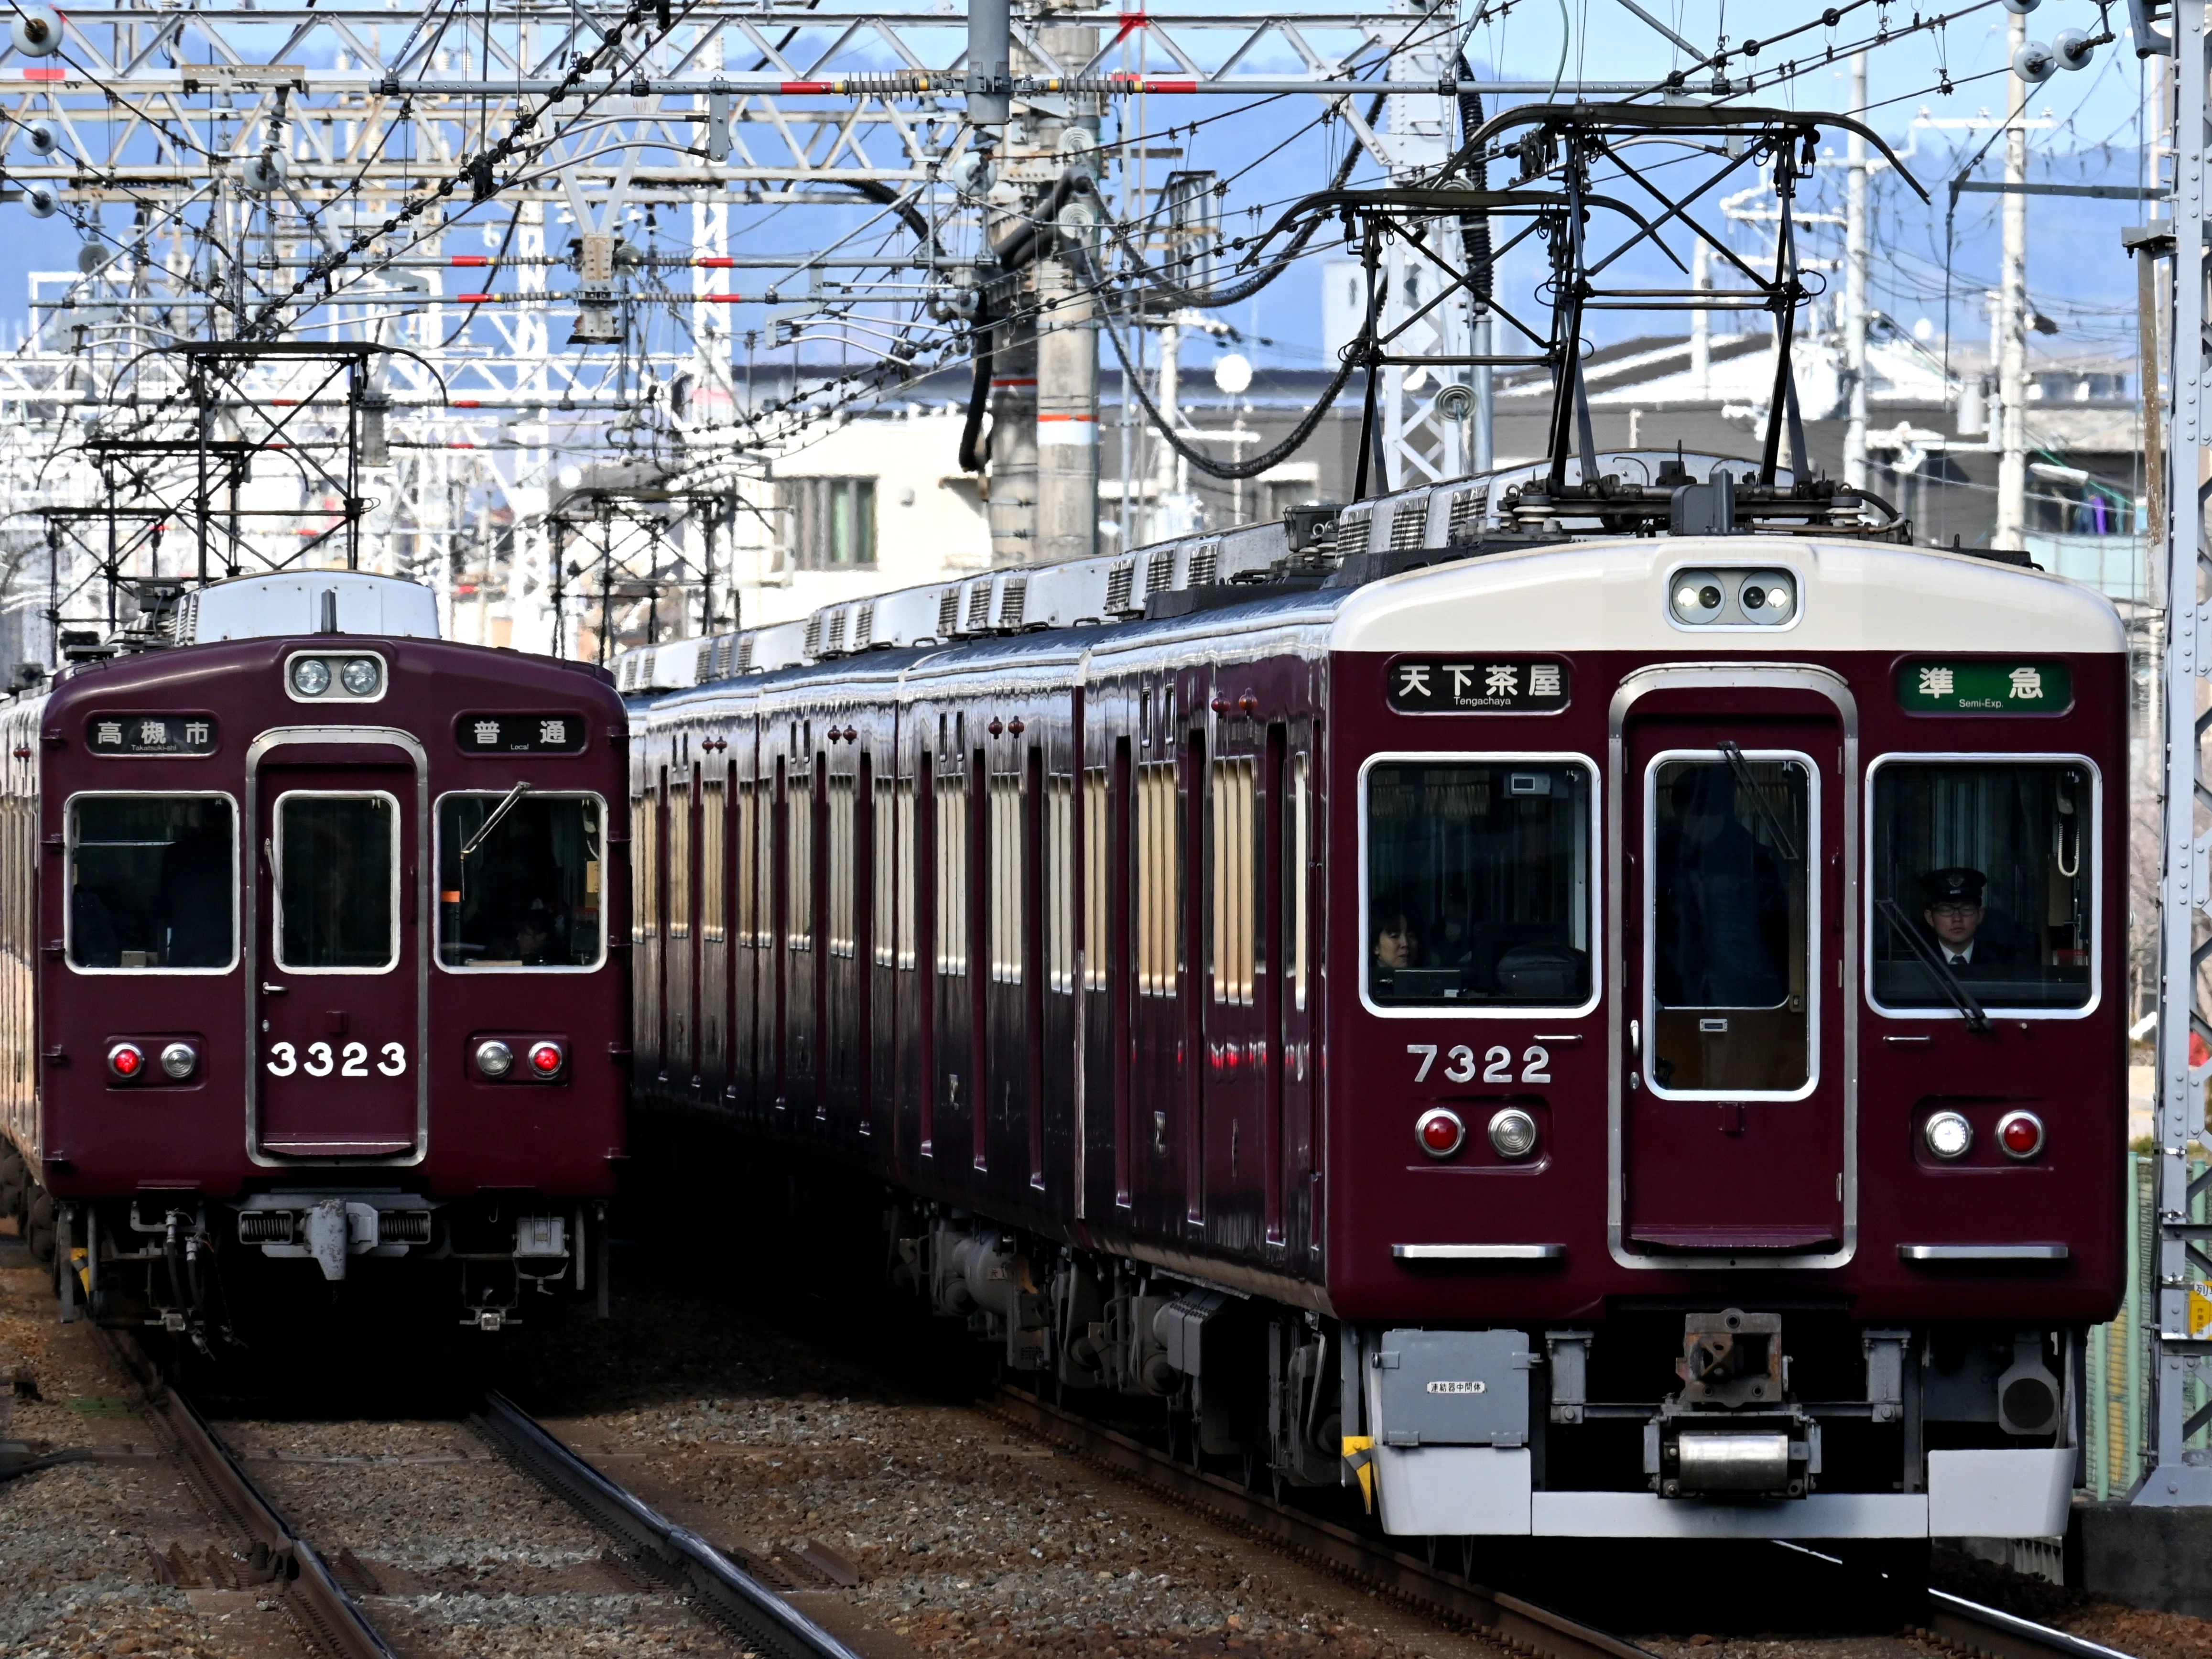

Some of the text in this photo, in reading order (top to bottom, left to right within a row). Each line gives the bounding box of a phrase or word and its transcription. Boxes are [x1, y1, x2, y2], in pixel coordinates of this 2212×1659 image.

[1399, 664, 1561, 697] 天下茶屋
[1919, 667, 2043, 699] 準急
[1453, 696, 1511, 707] Tengachaya
[1959, 699, 2004, 709] Semi-Exp.
[98, 721, 209, 745] 高槻市
[474, 720, 566, 744] 普通
[266, 1041, 406, 1077] 3323
[1407, 1044, 1551, 1084] 7322
[2196, 1284, 2212, 1296] 列
